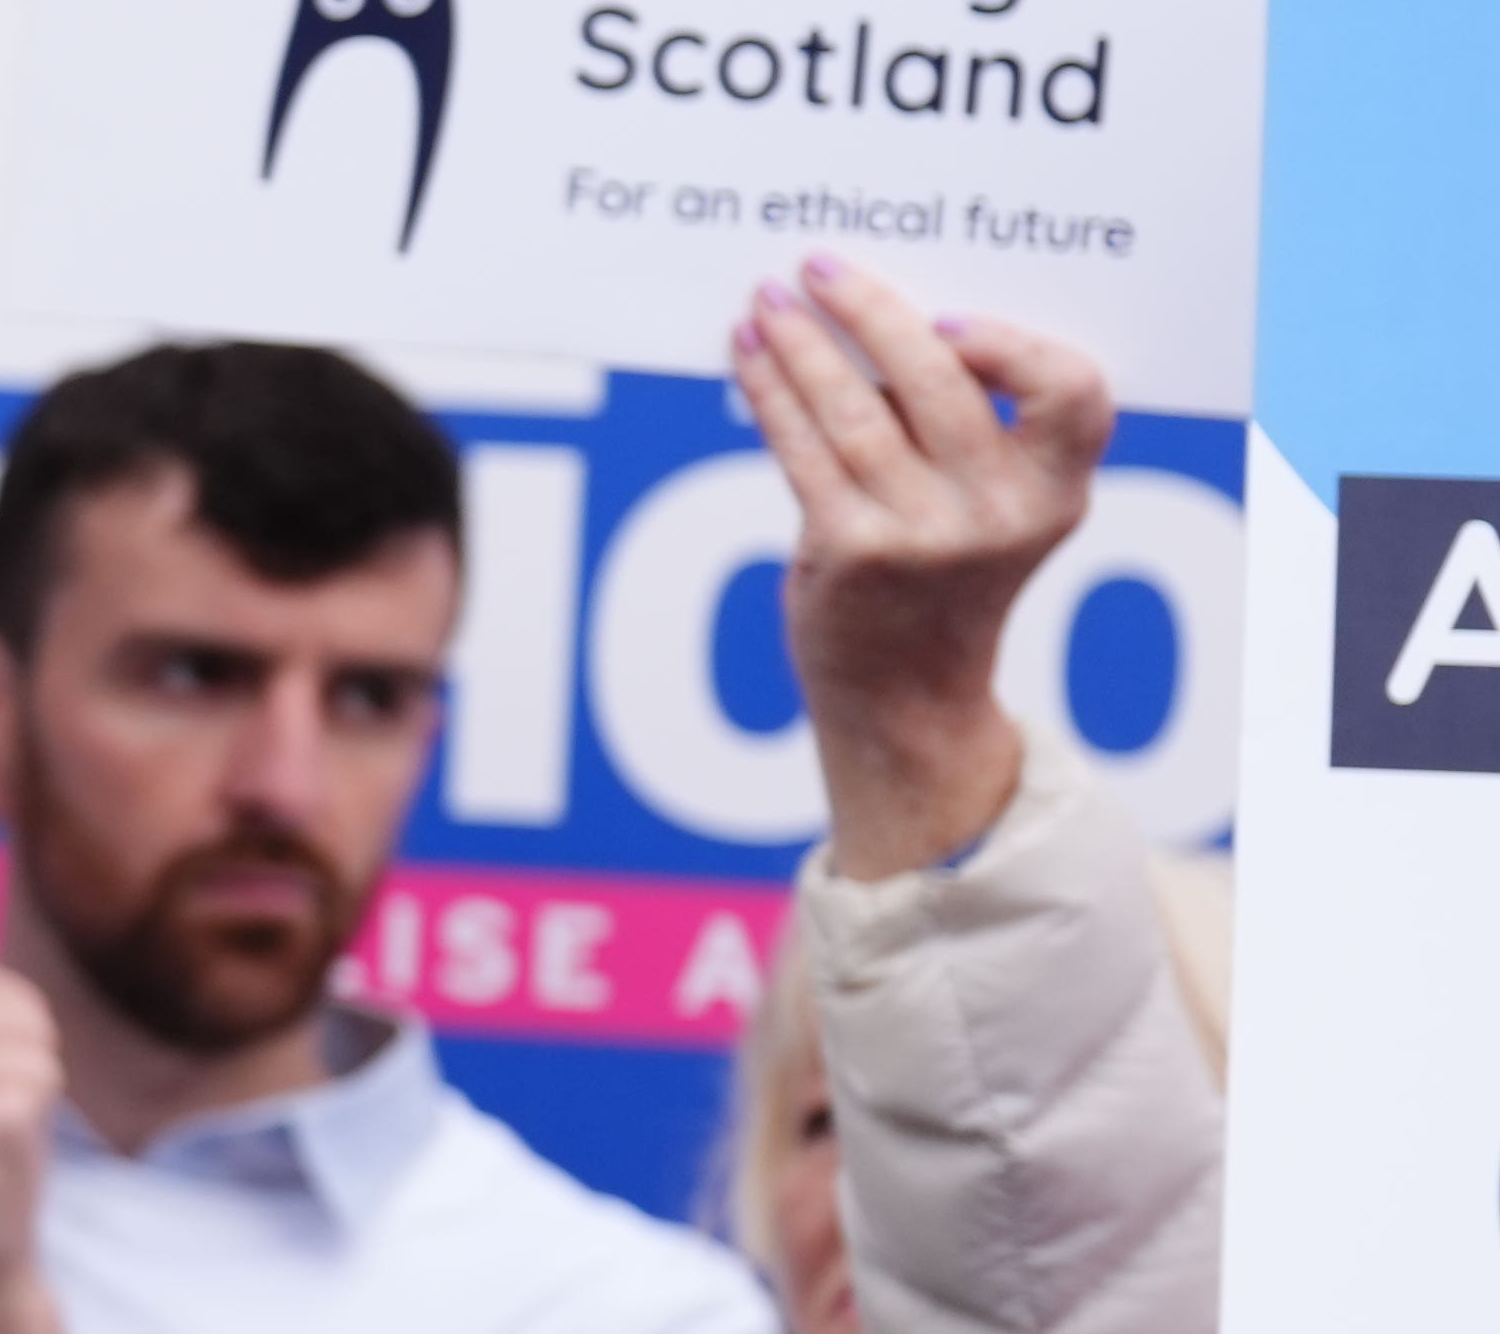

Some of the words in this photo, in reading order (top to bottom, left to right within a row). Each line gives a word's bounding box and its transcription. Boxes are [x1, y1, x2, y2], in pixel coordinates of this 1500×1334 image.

[572, 5, 1110, 127] Scotland
[563, 167, 646, 220] For
[672, 183, 742, 223] an
[759, 188, 944, 241] ethical
[965, 202, 1135, 257] future
